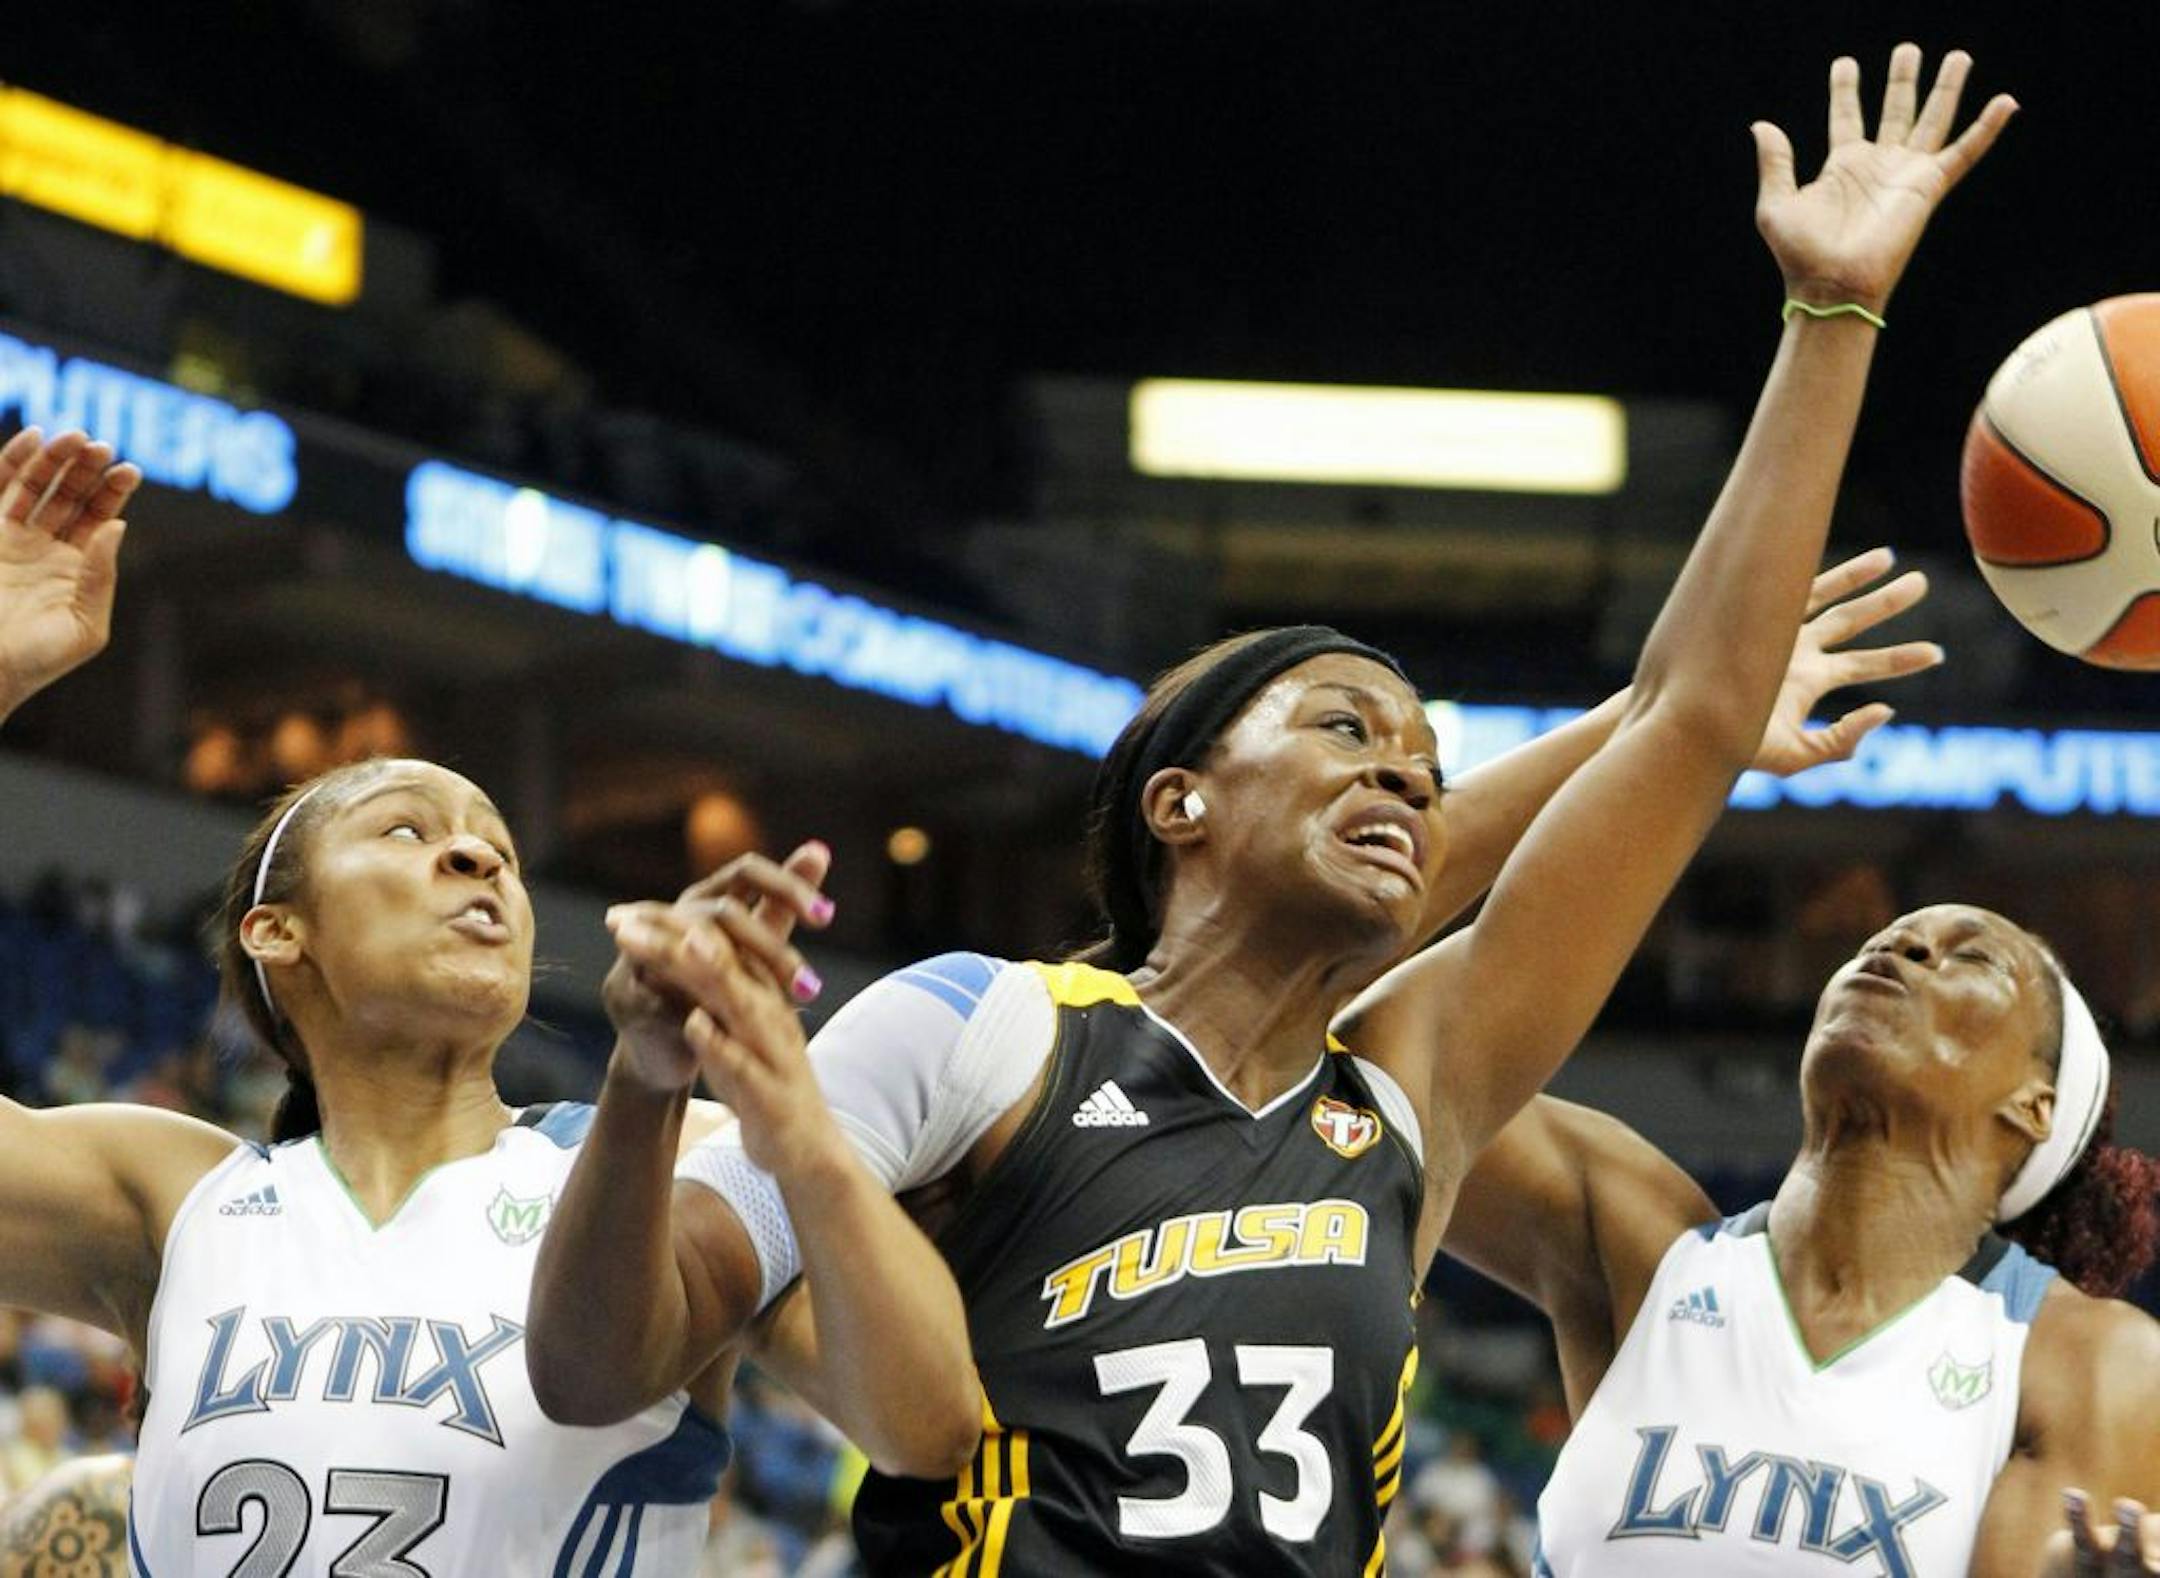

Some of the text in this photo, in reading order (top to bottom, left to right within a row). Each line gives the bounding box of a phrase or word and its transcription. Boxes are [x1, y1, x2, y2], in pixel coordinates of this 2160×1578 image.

[1073, 1111, 1149, 1127] adidas
[218, 1204, 284, 1217] adidas
[1041, 1199, 1369, 1329] TULSA
[180, 1306, 527, 1449] LYNX
[1093, 1337, 1335, 1542] 33
[197, 1458, 450, 1578] 23
[1606, 1425, 1949, 1578] LYNX
